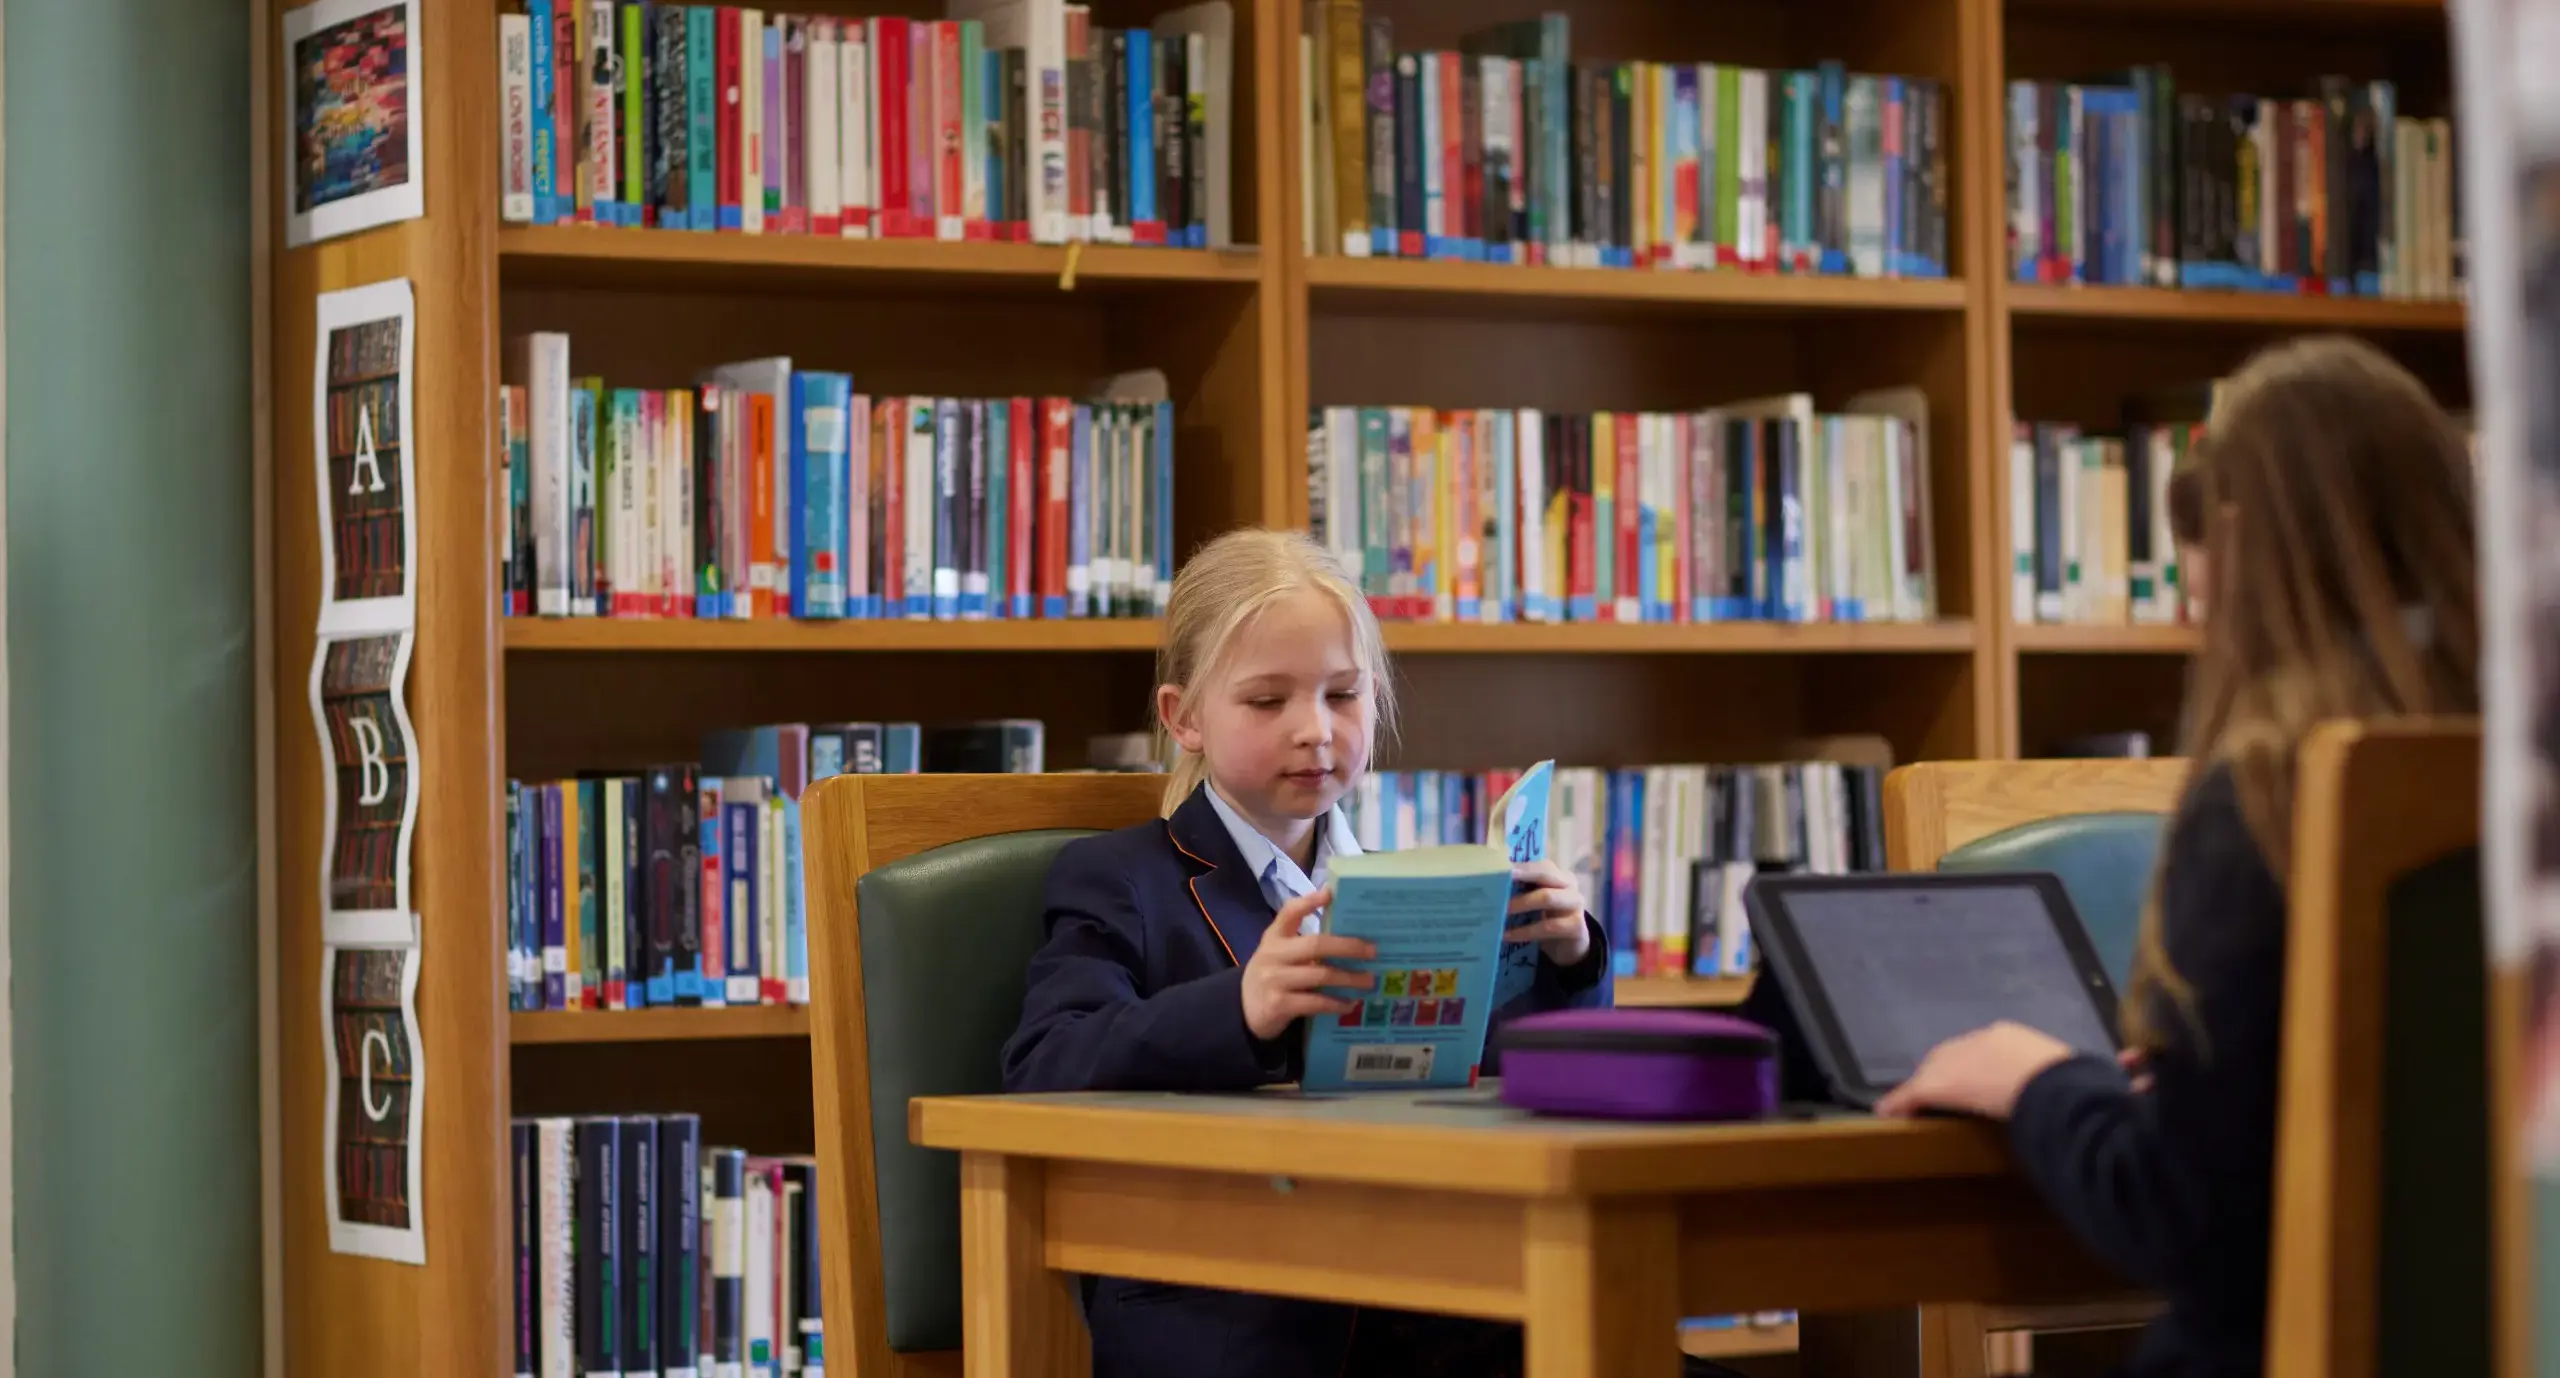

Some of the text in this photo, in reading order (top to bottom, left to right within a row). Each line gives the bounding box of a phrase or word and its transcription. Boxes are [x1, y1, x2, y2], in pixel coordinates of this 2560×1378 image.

[510, 85, 524, 134] LOVE
[535, 128, 549, 195] PERFECT
[349, 403, 386, 496] A
[350, 717, 389, 806] B
[361, 1029, 392, 1122] C
